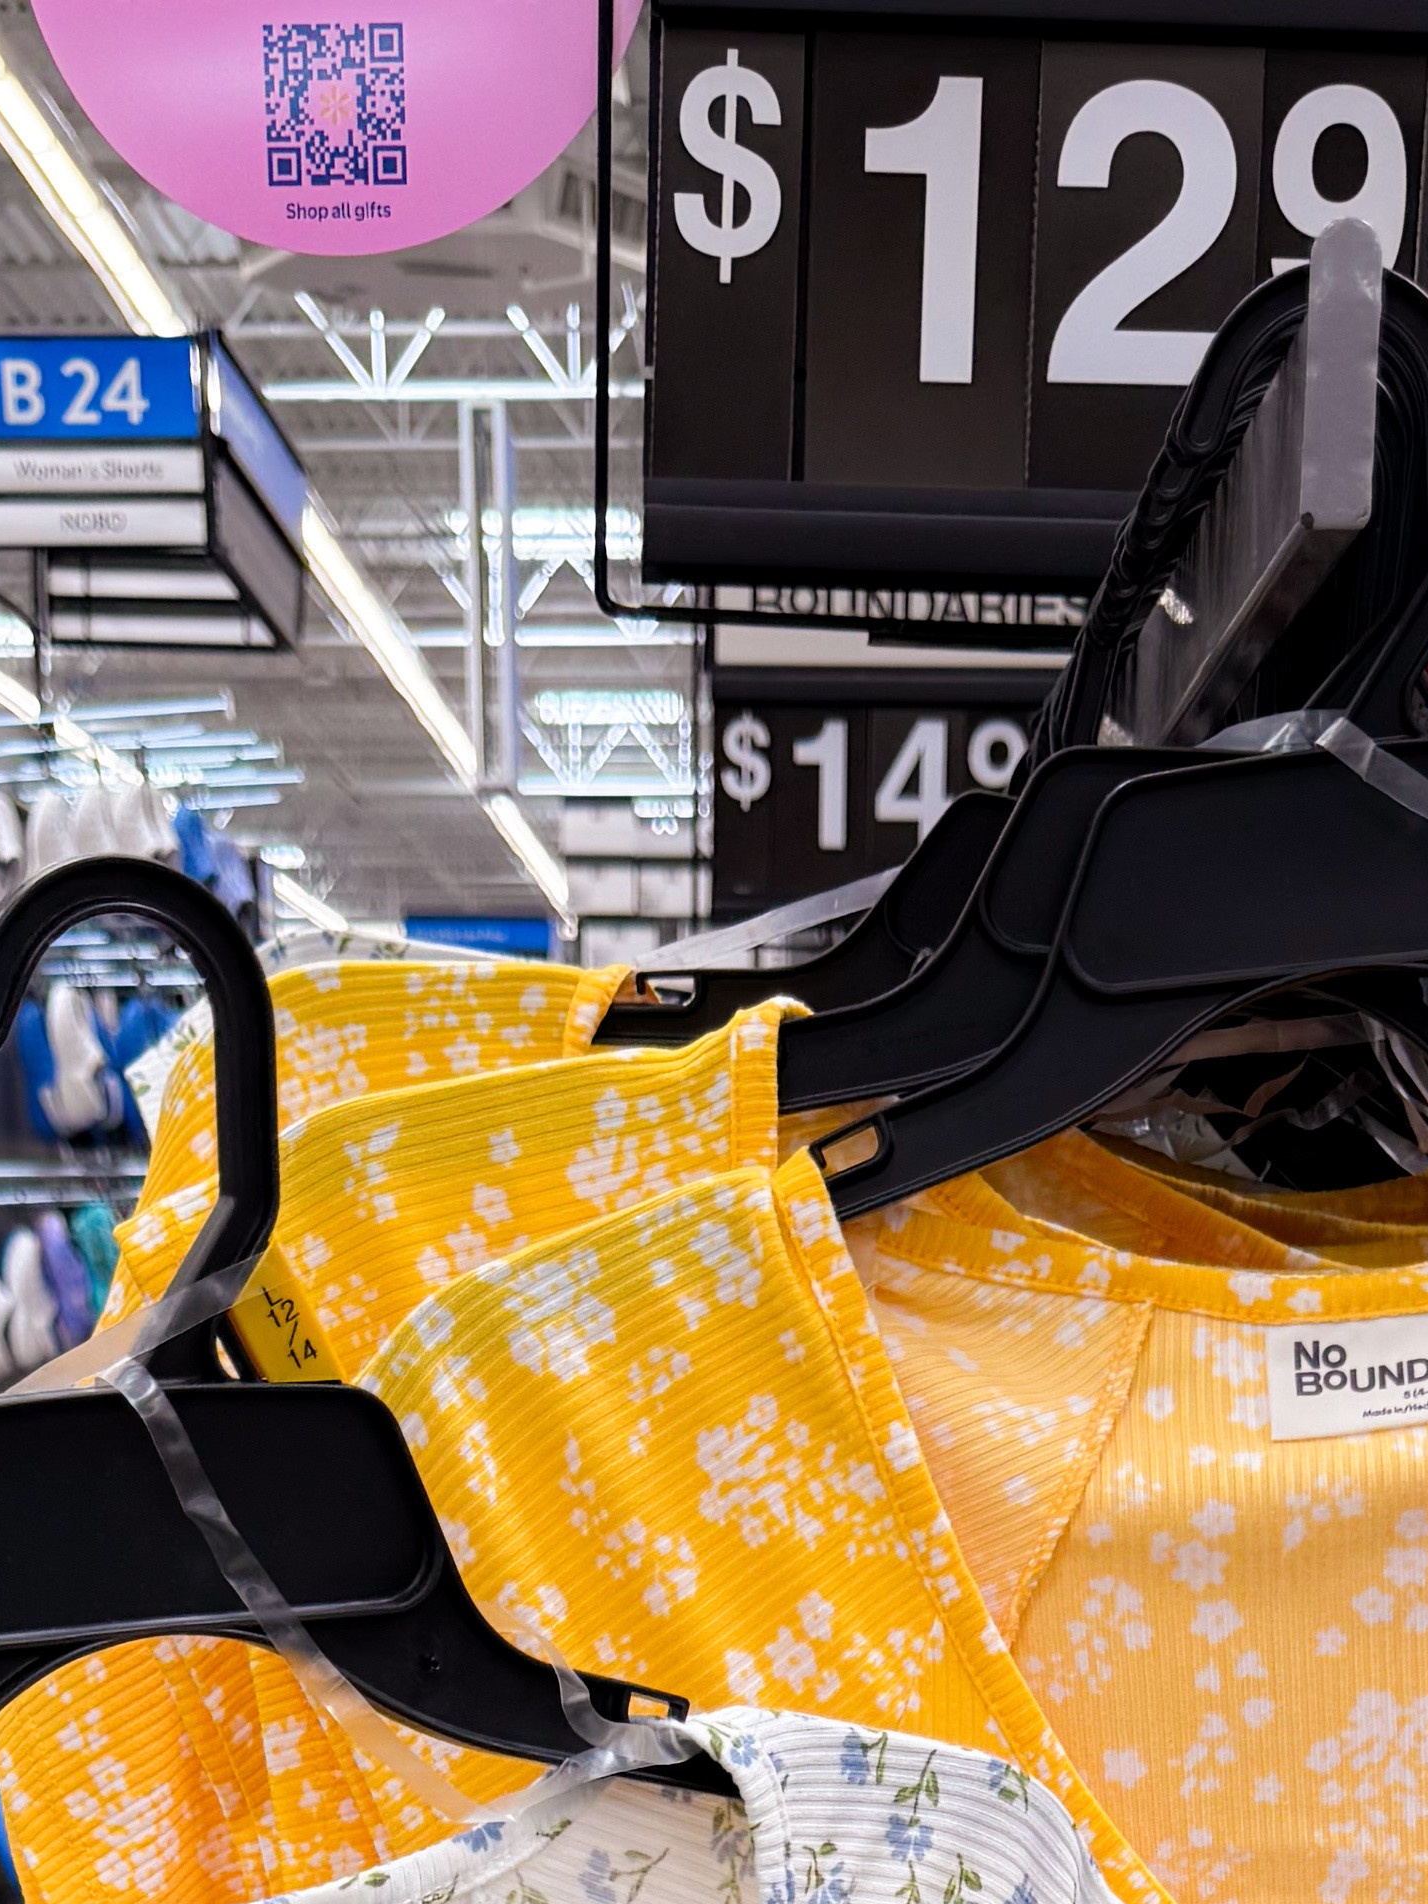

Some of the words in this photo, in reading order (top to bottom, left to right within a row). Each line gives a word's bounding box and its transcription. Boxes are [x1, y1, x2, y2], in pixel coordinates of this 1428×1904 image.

[286, 202, 329, 222] Shop
[331, 201, 351, 219] all
[354, 201, 391, 221] gifts
[0, 357, 46, 426] B
[59, 357, 151, 426] 24
[1293, 1340, 1347, 1371] No
